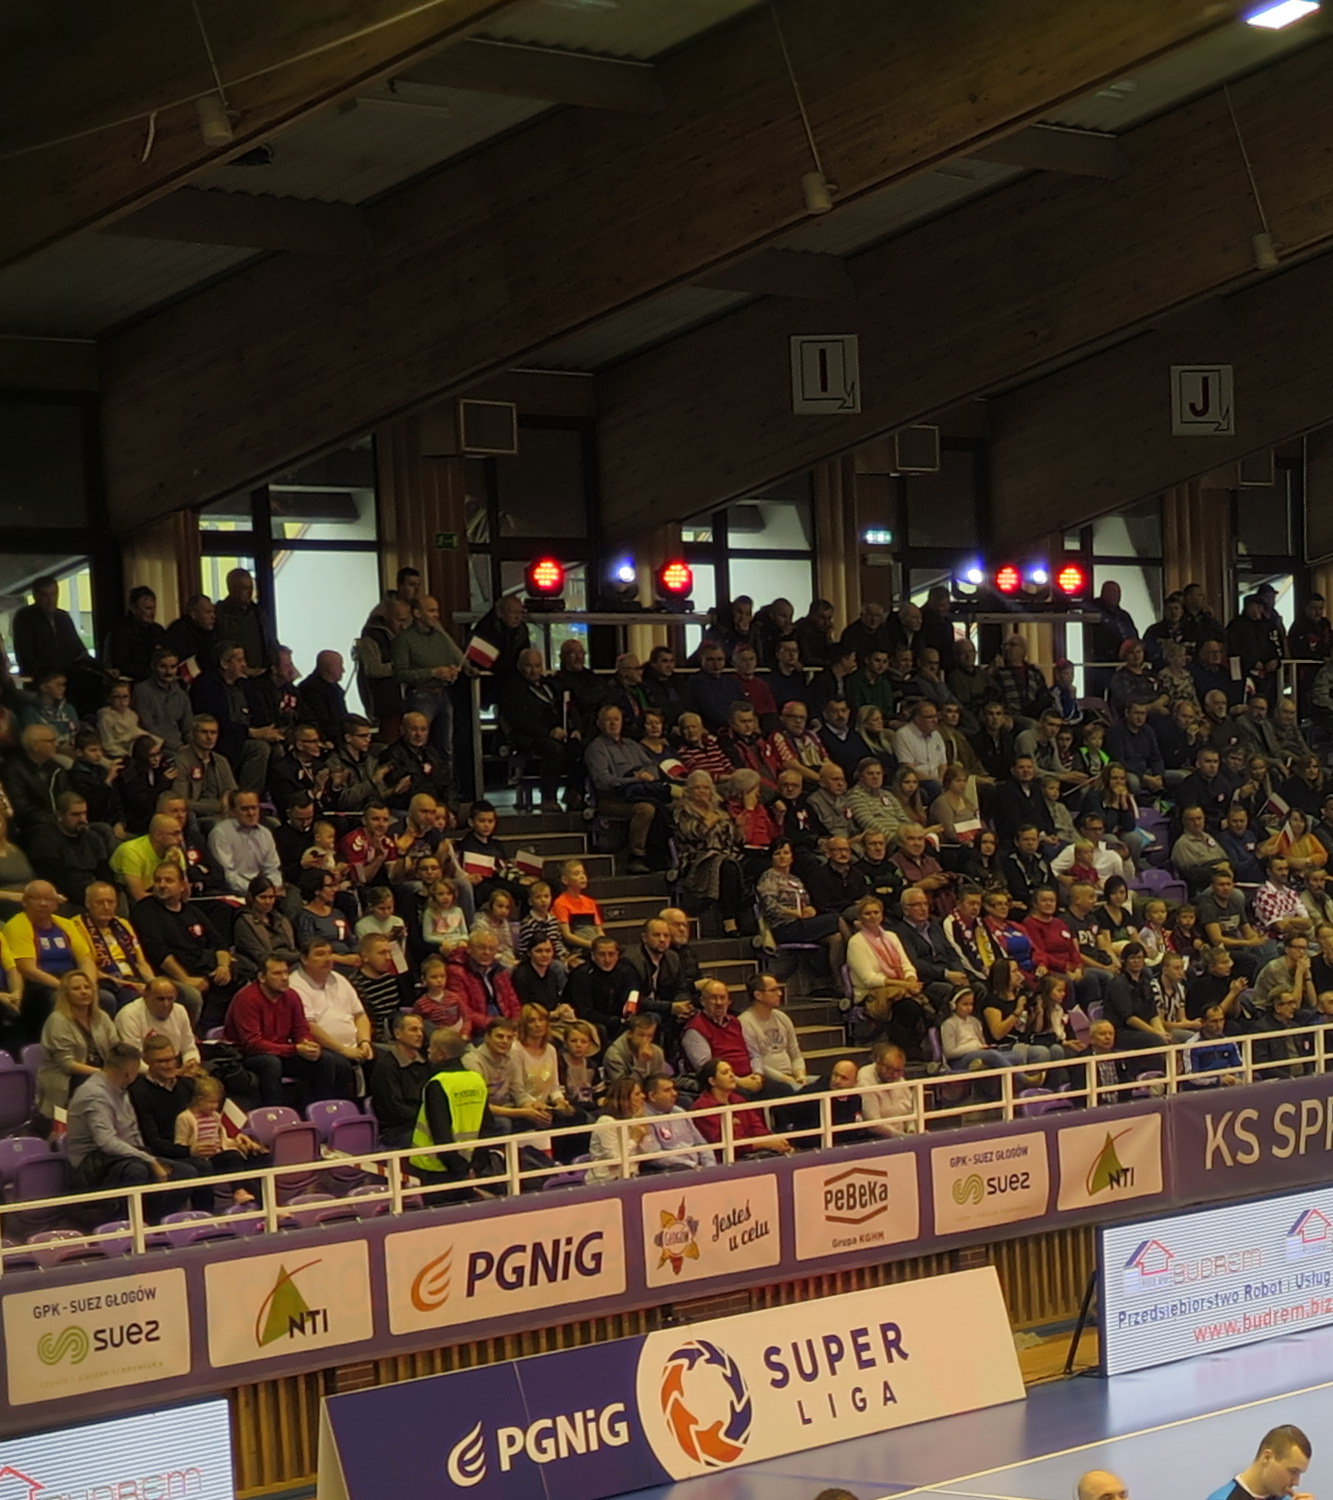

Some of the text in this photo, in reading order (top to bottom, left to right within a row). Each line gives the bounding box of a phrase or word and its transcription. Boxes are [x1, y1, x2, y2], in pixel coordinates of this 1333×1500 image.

[1187, 375, 1210, 418] J
[949, 1144, 1029, 1169] GPK SUEZ GŁOGÓW
[1203, 1108, 1261, 1171] KS
[823, 1180, 889, 1212] PeBeKa
[1108, 1166, 1135, 1191] NTI
[711, 1199, 752, 1242] Jesteś
[741, 1220, 770, 1248] celu
[831, 1231, 885, 1249] Grupa KGHM
[465, 1231, 604, 1298] PGNiG
[33, 1286, 157, 1319] GPK SUEZ GŁOGÓW
[288, 1308, 329, 1339] NTI
[763, 1321, 911, 1390] SUPER
[797, 1380, 898, 1426] LIGA
[497, 1402, 632, 1473] PGNiG
